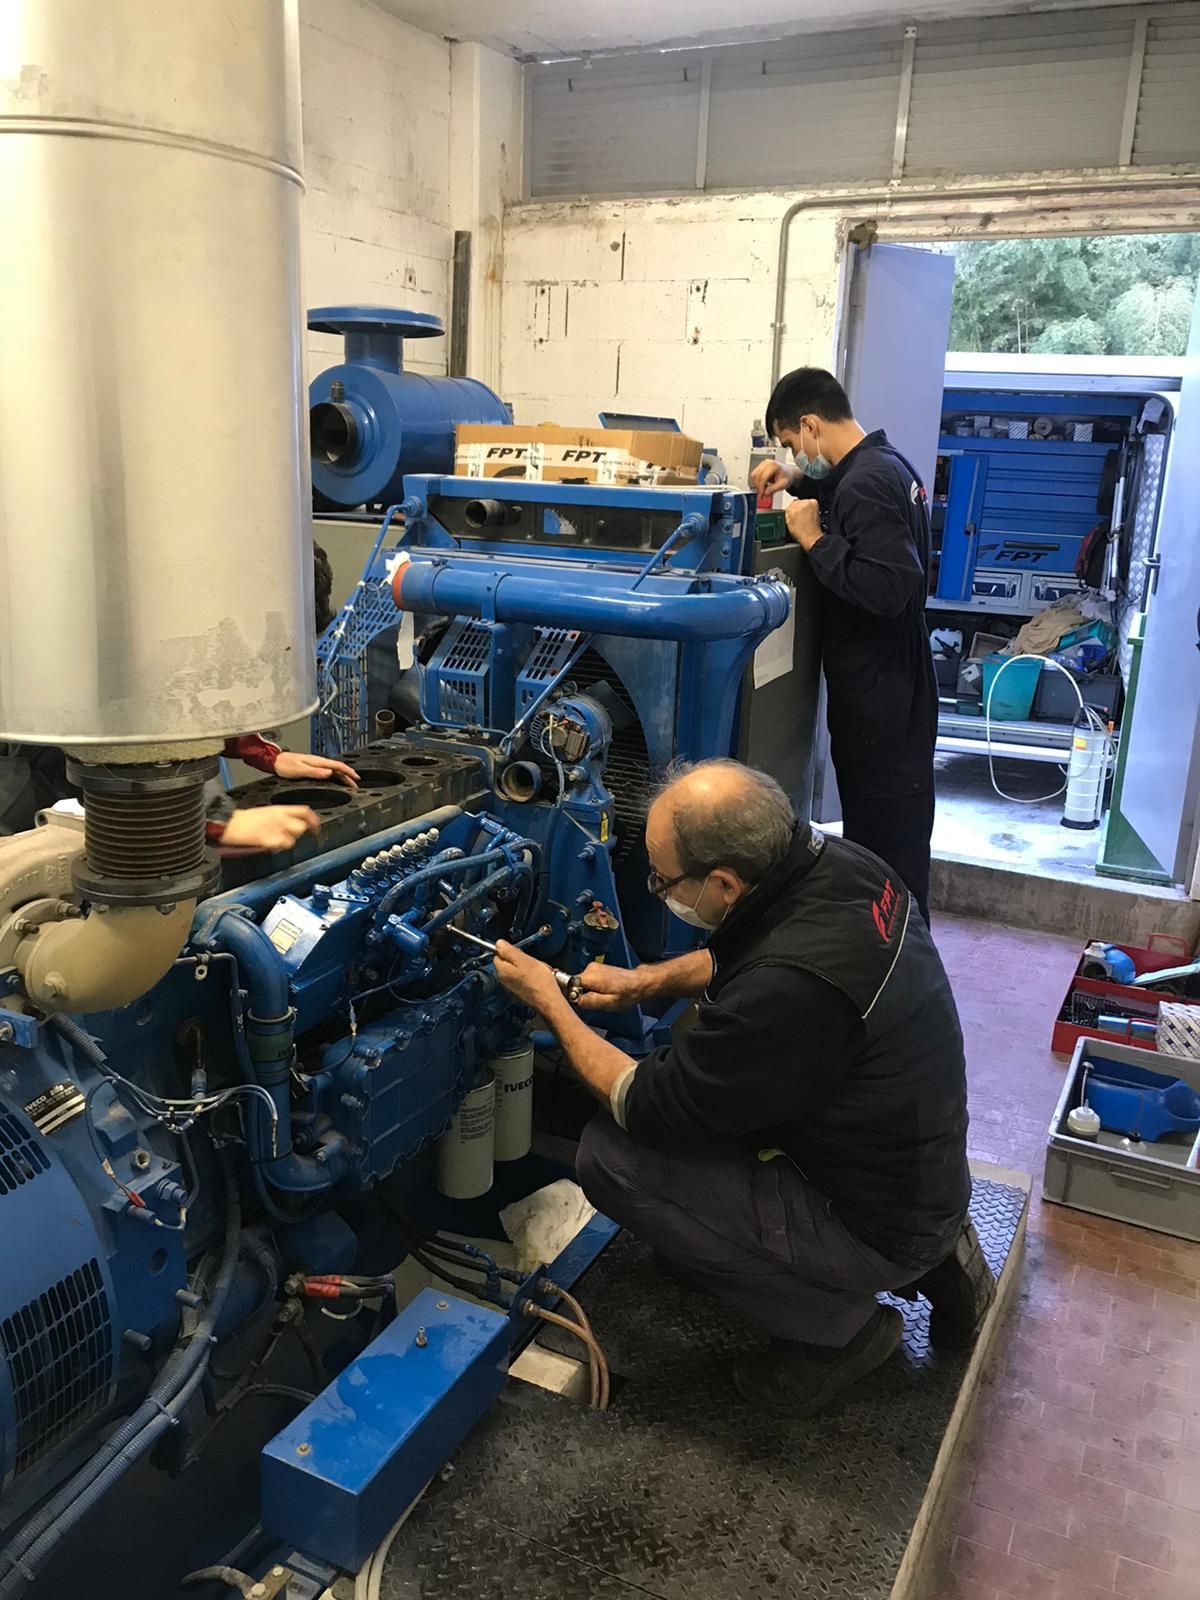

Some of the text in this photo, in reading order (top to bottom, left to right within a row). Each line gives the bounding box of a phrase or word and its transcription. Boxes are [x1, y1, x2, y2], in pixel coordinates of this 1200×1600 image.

[486, 447, 528, 459] FPT
[562, 449, 607, 463] FPT
[994, 550, 1048, 563] FPT
[24, 1095, 46, 1112] IVECO
